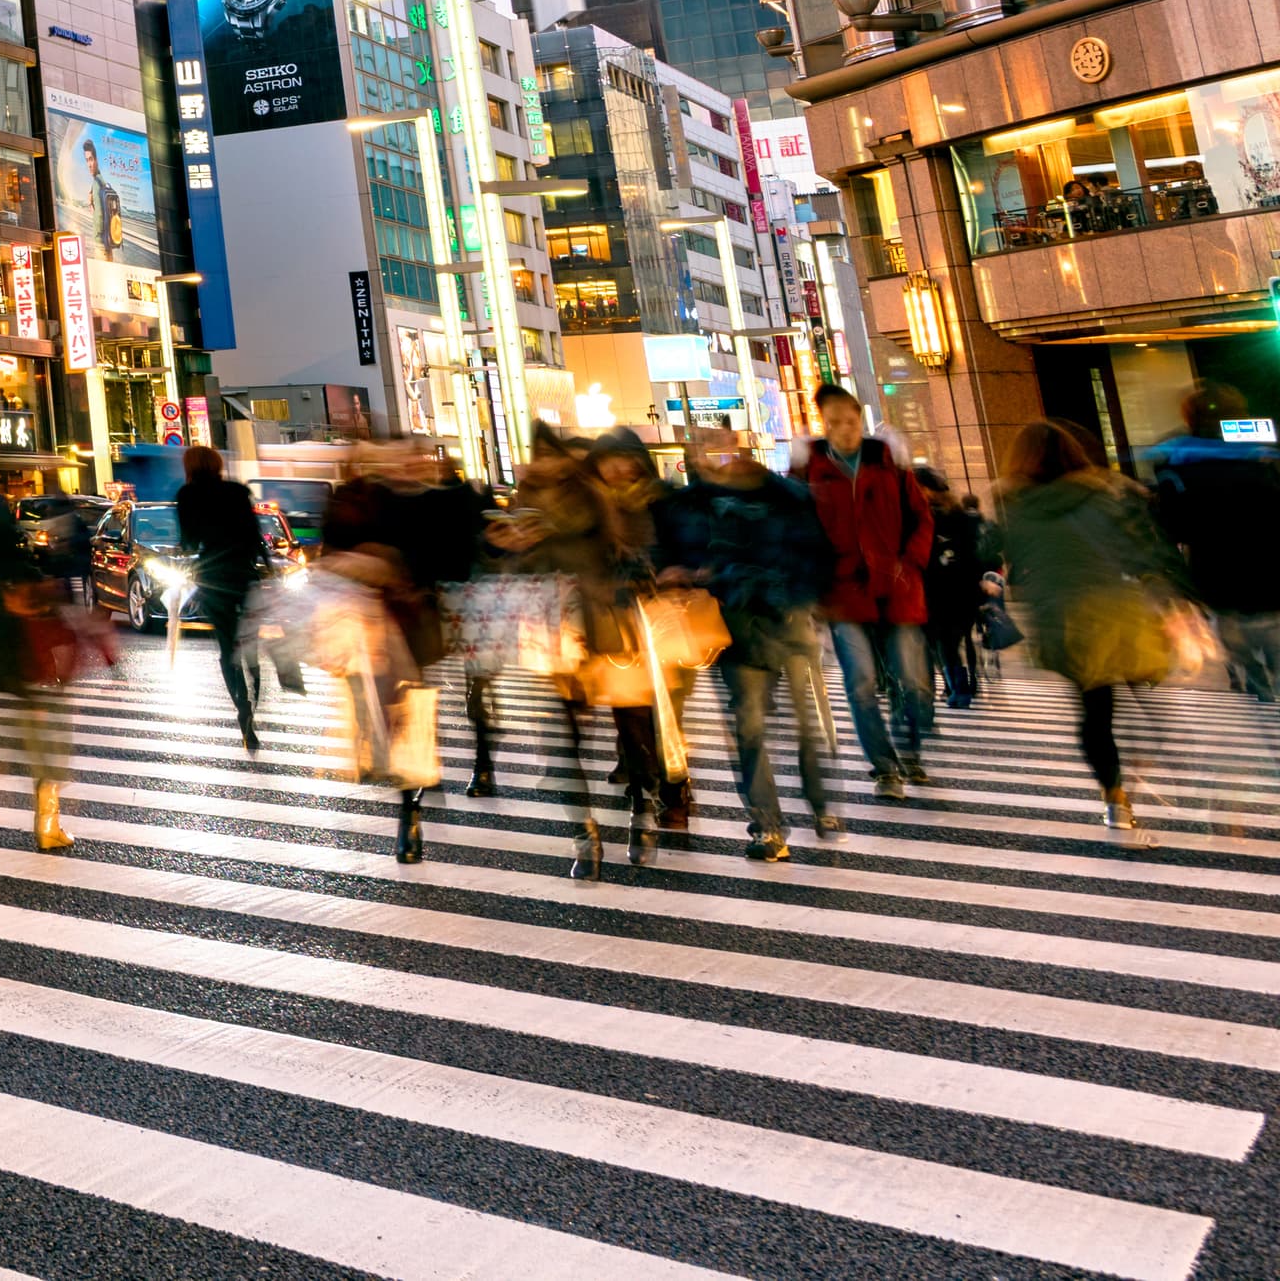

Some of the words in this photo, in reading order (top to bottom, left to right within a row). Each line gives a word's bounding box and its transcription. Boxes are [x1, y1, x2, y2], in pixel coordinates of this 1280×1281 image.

[245, 63, 297, 80] SEIKO
[243, 76, 303, 95] ASTRON
[272, 95, 298, 106] GPS
[273, 104, 299, 113] SOLAR
[175, 59, 214, 190] 山野楽器
[520, 76, 546, 156] 教文館ビル
[356, 287, 372, 351] ZENITH
